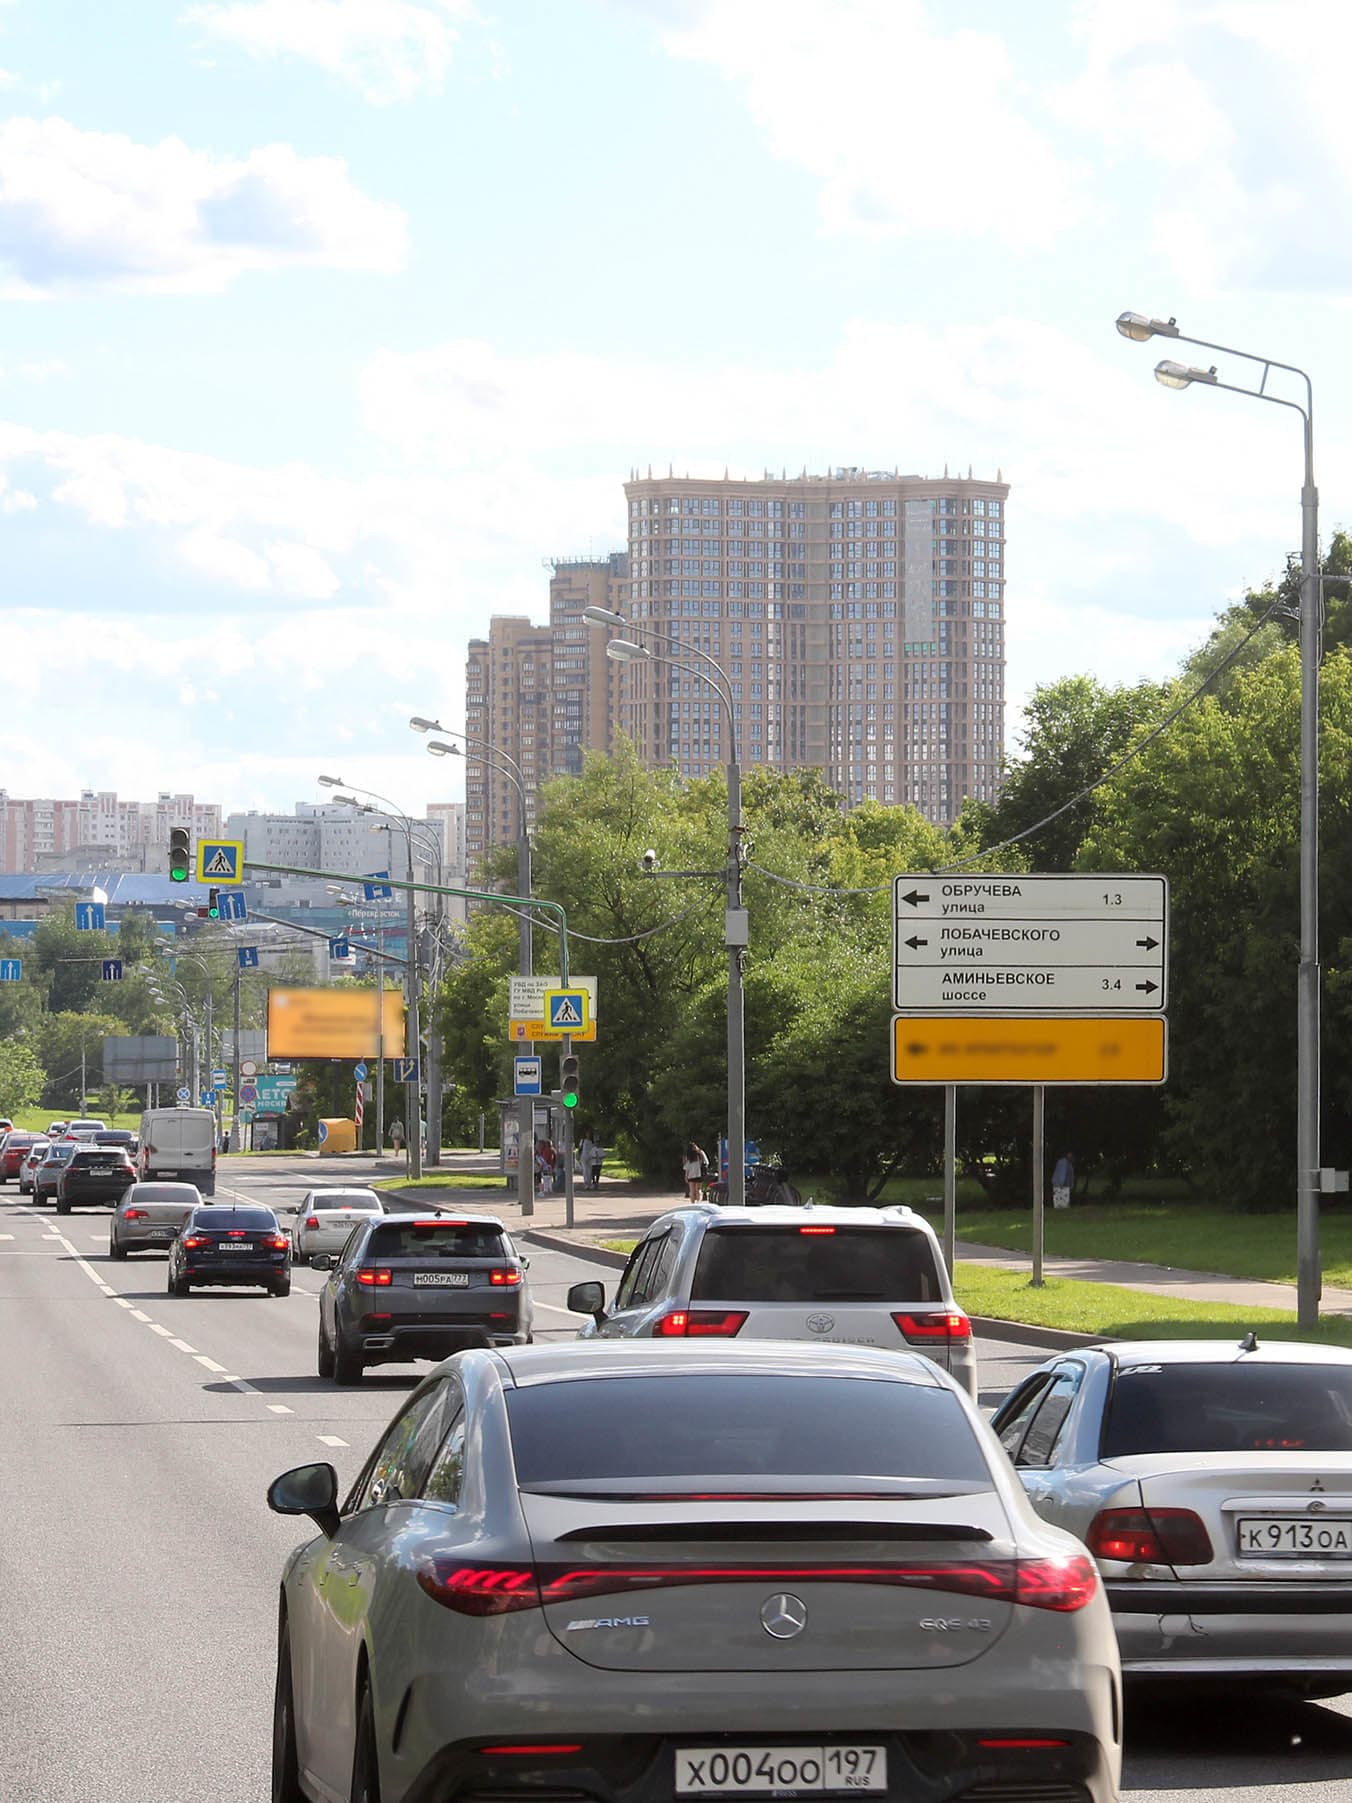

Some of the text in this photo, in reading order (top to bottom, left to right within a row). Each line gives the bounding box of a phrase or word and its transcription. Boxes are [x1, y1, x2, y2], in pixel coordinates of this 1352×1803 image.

[942, 885, 1022, 897] ОБРУЧЕВА
[1103, 894, 1122, 905] 1.3
[942, 904, 985, 914] улица
[940, 929, 1060, 941] ЛОБАЧЕВСКОГО
[940, 947, 983, 958] улица
[942, 973, 1055, 985] АМИНЬЕВСКОЕ
[1102, 979, 1121, 990] 3.4
[942, 991, 986, 1001] шоссе
[1250, 1524, 1348, 1548] К913ОА
[594, 1616, 650, 1628] AMG
[687, 1750, 877, 1786] Х004ОО 197
[845, 1776, 869, 1786] RUS
